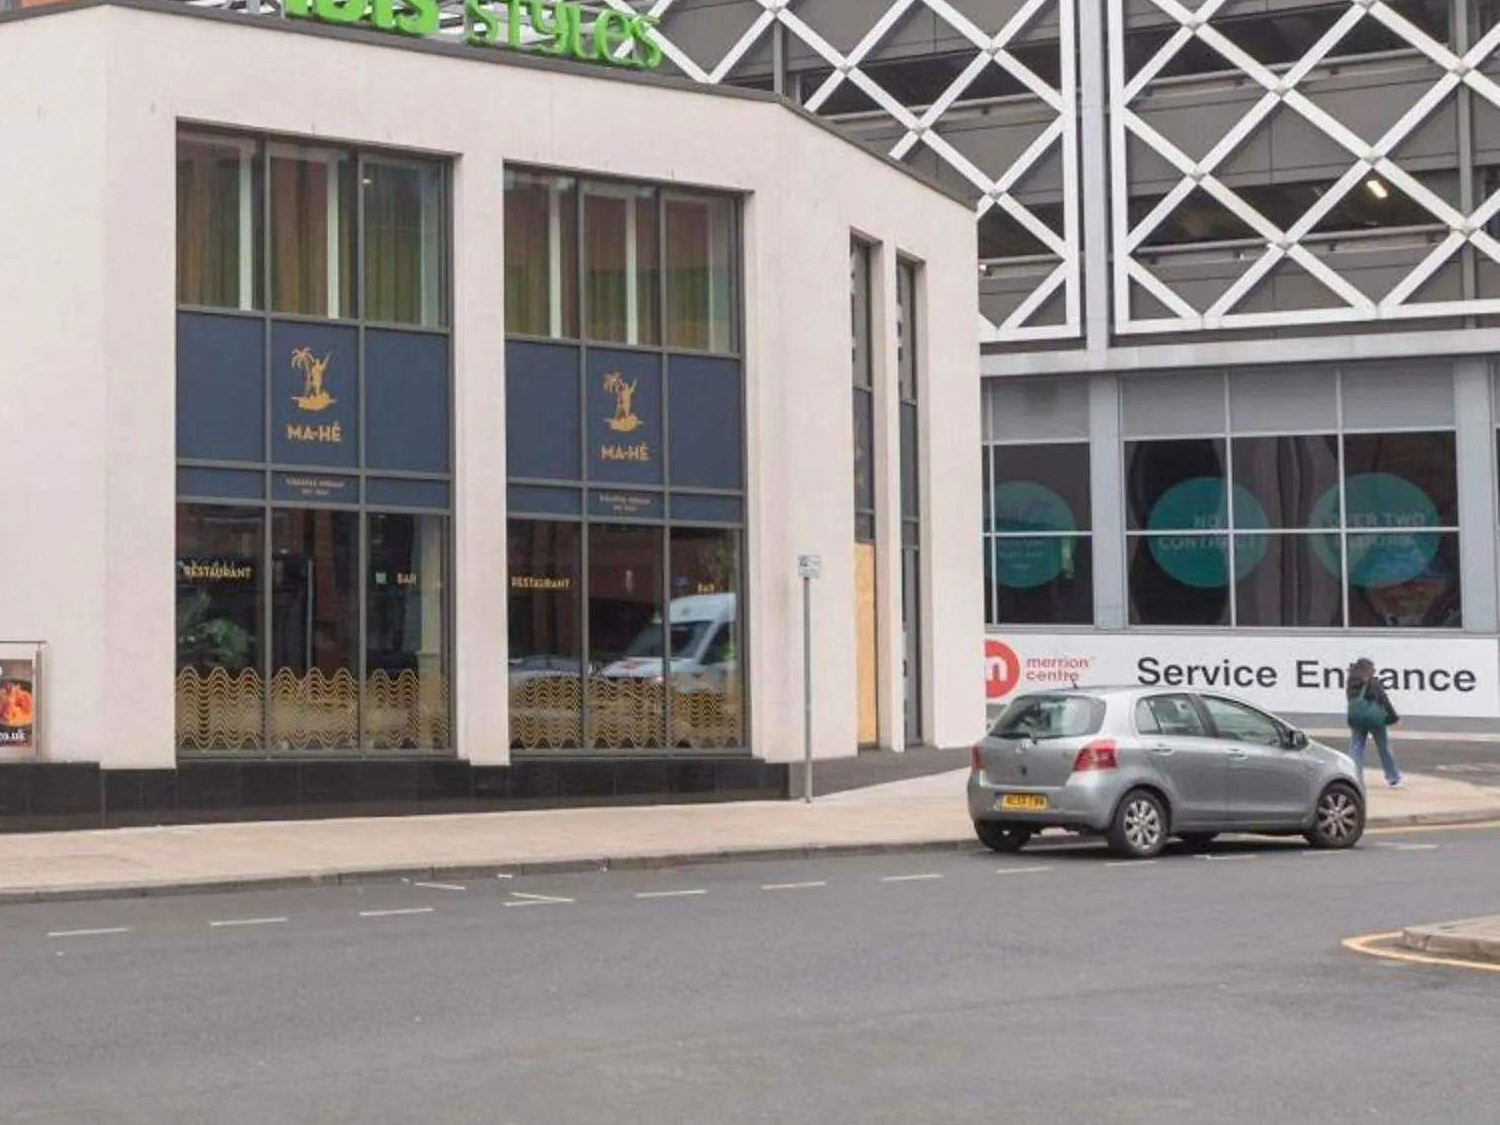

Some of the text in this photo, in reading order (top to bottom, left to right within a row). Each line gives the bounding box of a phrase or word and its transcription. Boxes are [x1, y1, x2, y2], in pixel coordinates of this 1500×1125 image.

[286, 420, 342, 444] MA-HÉ
[601, 442, 649, 461] MA-HÉ
[396, 572, 417, 585] BAR
[511, 577, 570, 589] RESTAURANT
[1026, 656, 1089, 668] merrion
[1026, 669, 1080, 682] centre
[1137, 656, 1477, 692] Service Enance
